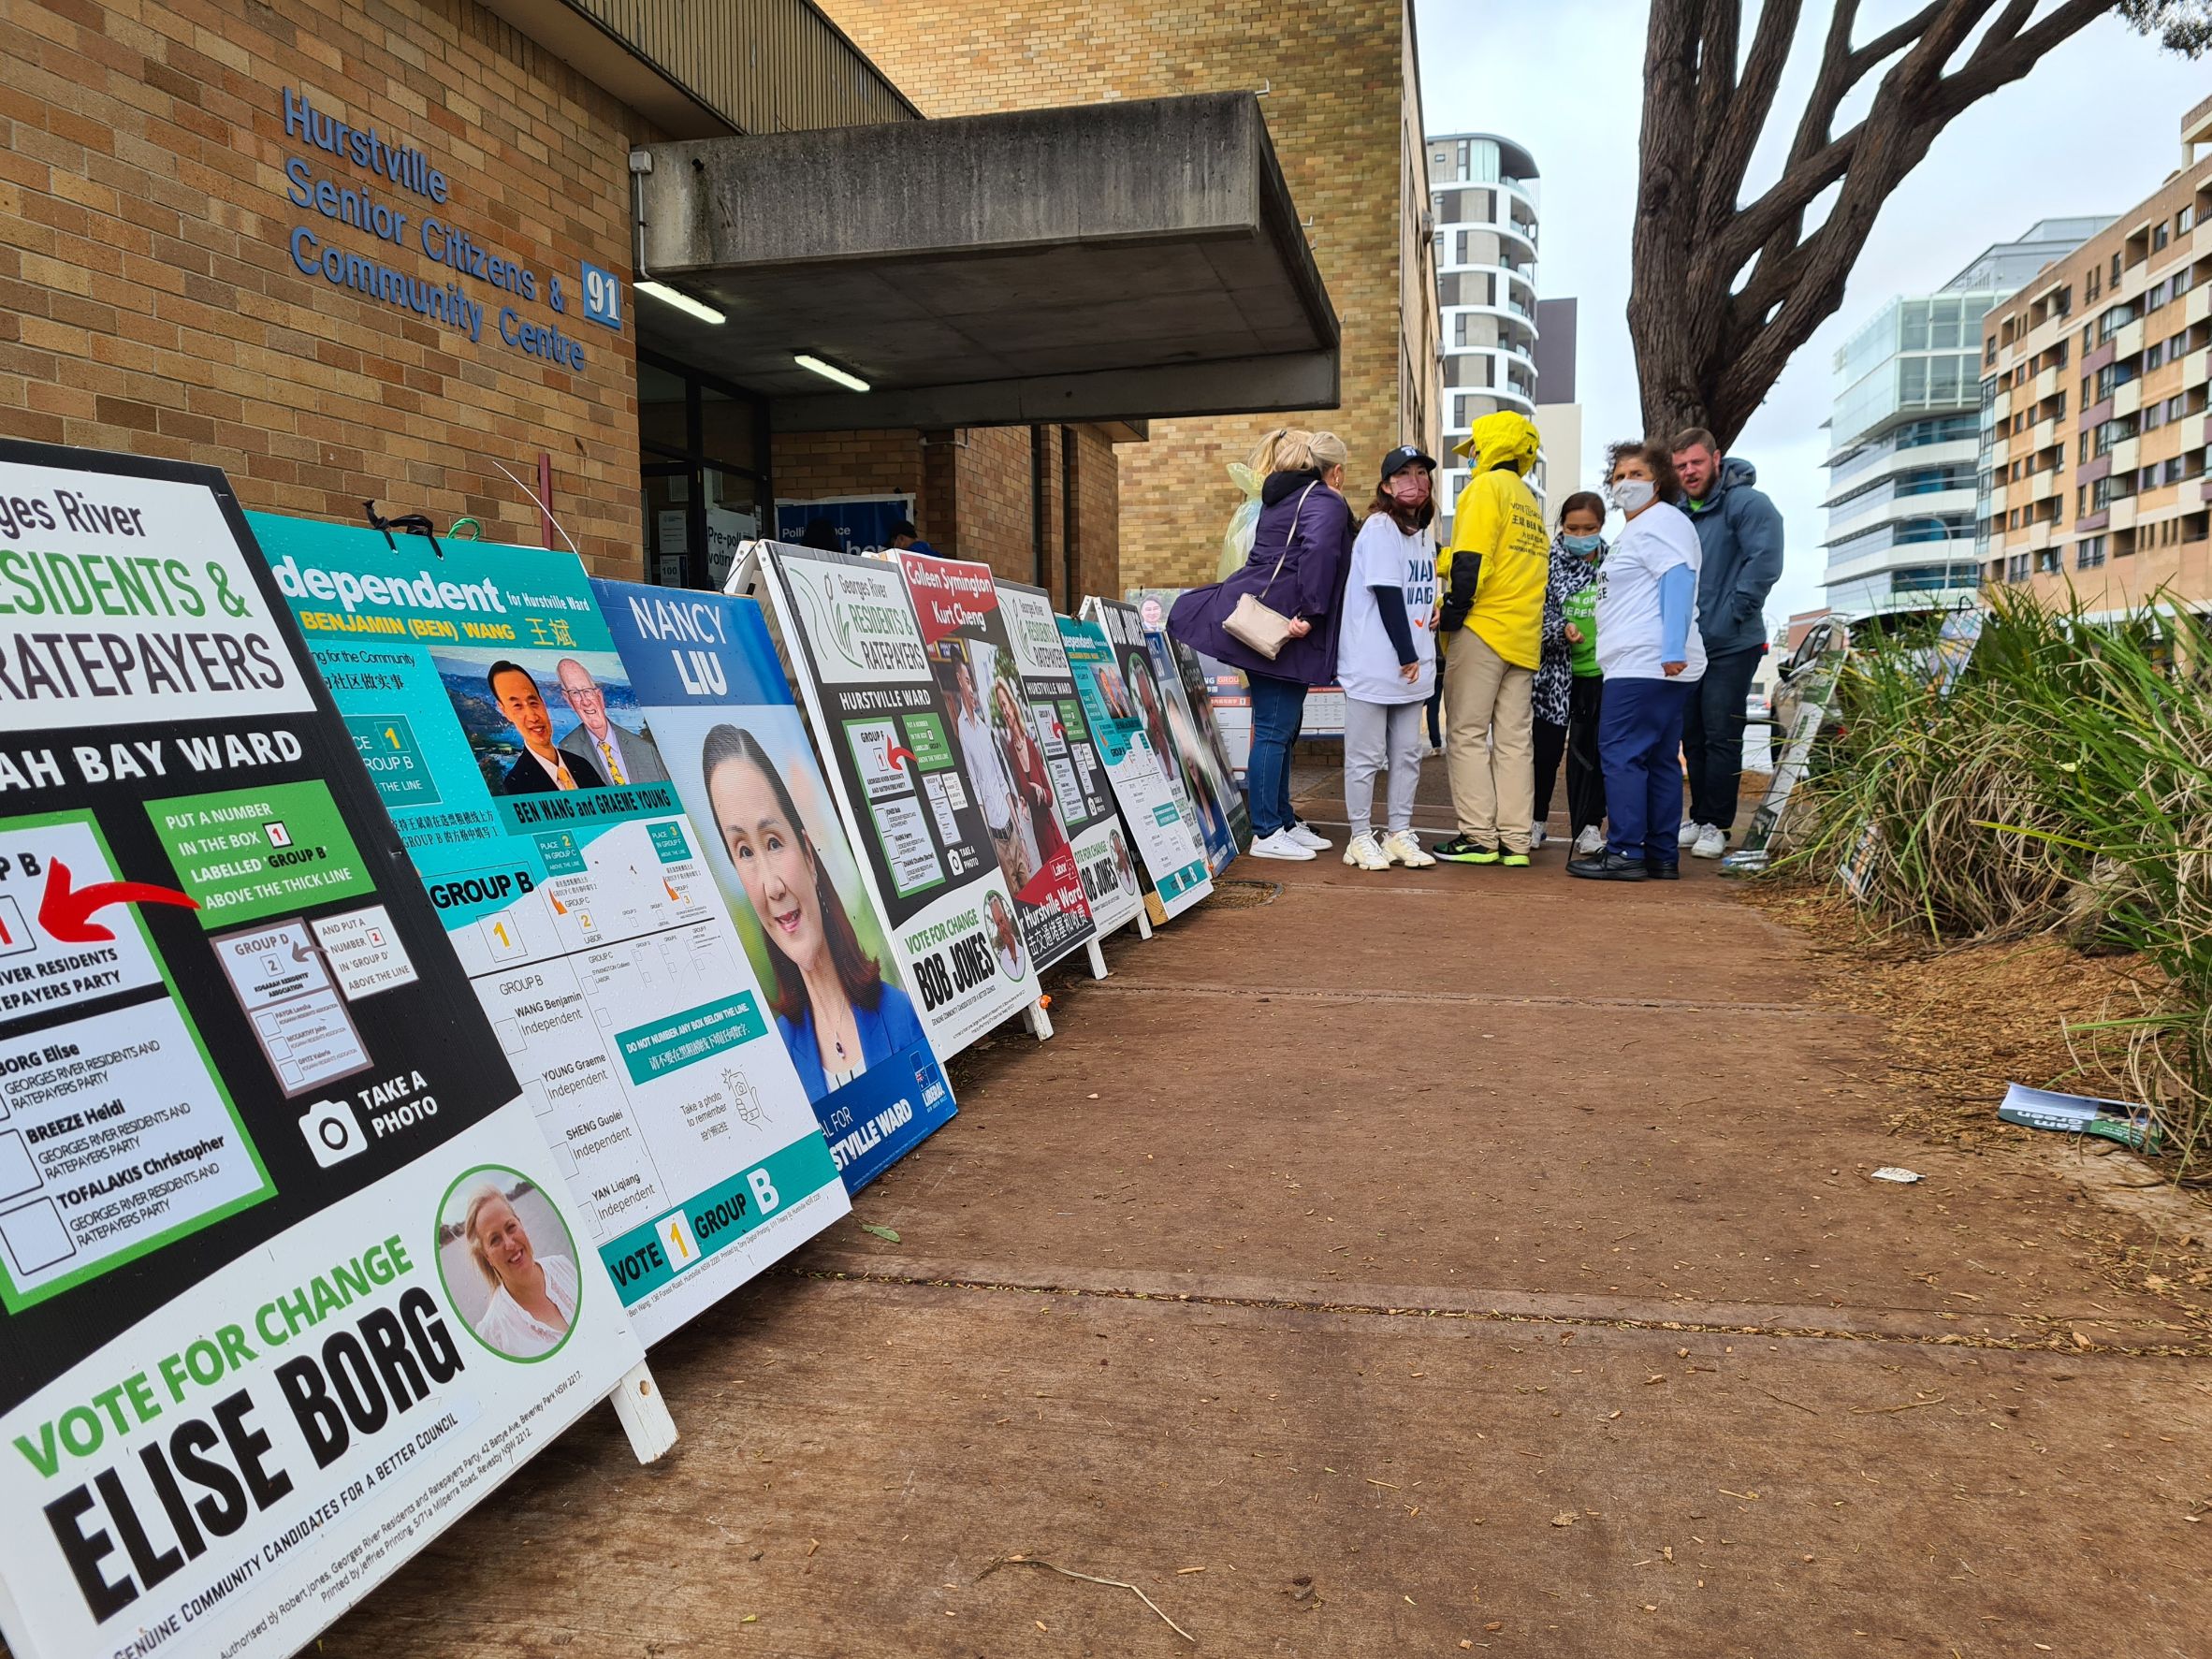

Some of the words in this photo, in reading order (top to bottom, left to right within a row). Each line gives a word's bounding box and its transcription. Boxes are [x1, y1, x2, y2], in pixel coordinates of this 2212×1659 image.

[283, 86, 448, 204] Hurstville
[285, 156, 407, 244] Senior
[421, 218, 536, 300] Citizens
[549, 276, 566, 313] &
[290, 226, 483, 342] Community
[499, 307, 585, 371] Centre
[588, 271, 619, 320] 91
[54, 489, 146, 536] River
[707, 526, 741, 546] Pre-poll
[782, 528, 806, 539] Polli
[271, 554, 506, 613] dependent
[506, 590, 521, 607] for
[521, 592, 566, 610] Hurstville
[567, 593, 590, 611] Ward
[662, 565, 677, 575] 100
[838, 574, 867, 601] Georges
[867, 577, 888, 599] River
[907, 561, 941, 586] Colleen
[941, 567, 993, 598] Symington
[206, 560, 254, 618] &
[299, 611, 406, 634] BENJAMIN
[409, 618, 458, 641] (BEN)
[463, 622, 516, 640] WANG
[524, 618, 576, 648] 王斌
[629, 597, 727, 644] NANCY
[848, 604, 905, 635] RESIDENTS
[903, 615, 914, 636] &
[932, 601, 953, 625] Kurt
[953, 608, 986, 631] Cheng
[327, 649, 339, 662] for
[342, 650, 359, 662] the
[359, 651, 415, 667] Community
[672, 649, 728, 695] LIU
[860, 640, 924, 670] RATEPAYERS
[839, 691, 901, 710] HURSTVILLE
[905, 689, 931, 706] WARD
[72, 741, 168, 783] BAY
[176, 730, 302, 772] WARD
[166, 813, 195, 829] PUT
[199, 812, 211, 824] A
[211, 803, 273, 822] NUMBER
[515, 801, 538, 823] BEN
[540, 797, 574, 822] WANG
[577, 797, 595, 815] and
[596, 793, 635, 815] GRAEME
[635, 788, 671, 809] YOUNG
[179, 842, 197, 856] IN
[197, 837, 228, 853] THE
[228, 831, 261, 847] BOX
[272, 828, 283, 841] 1
[960, 847, 971, 856] TAKE
[191, 859, 262, 883] LABELLED
[964, 858, 979, 870] PHOTO
[1053, 862, 1067, 876] Labor
[1093, 857, 1118, 897] JONES
[205, 889, 255, 910] ABOVE
[252, 881, 283, 899] THE
[280, 873, 323, 894] THICK
[323, 868, 353, 884] LINE
[429, 875, 511, 910] GROUP
[518, 870, 534, 895] B
[1023, 893, 1061, 929] Hurstville
[1057, 880, 1084, 908] Ward
[493, 921, 511, 948] 1
[905, 930, 932, 955] VOTE
[929, 922, 947, 945] FOR
[946, 909, 979, 937] CHANGE
[500, 977, 534, 996] GROUP
[534, 975, 543, 986] B
[912, 953, 953, 1011] BOB
[949, 932, 996, 994] JONES
[515, 1002, 544, 1018] WANG
[545, 992, 582, 1010] Benjamin
[521, 1008, 583, 1036] Independent
[626, 1042, 637, 1054] DO
[637, 1037, 651, 1048] NOT
[651, 1028, 678, 1044] NUMBER
[678, 1024, 691, 1035] ANY
[691, 1019, 704, 1030] BOX
[704, 1011, 724, 1026] BELOW
[724, 1008, 735, 1018] THE
[5, 1070, 57, 1095] GEORGES
[56, 1062, 85, 1078] RIVER
[85, 1046, 138, 1070] RESIDENTS
[138, 1041, 159, 1055] AND
[44, 1043, 80, 1063] Elise
[542, 1064, 575, 1083] YOUNG
[575, 1054, 605, 1070] Graeme
[10, 1080, 78, 1111] RATEPAYERS
[77, 1070, 109, 1091] PARTY
[358, 1077, 406, 1111] TAKE
[409, 1070, 428, 1089] A
[547, 1069, 608, 1099] Independent
[922, 1082, 945, 1107] LIBERAL
[371, 1097, 438, 1138] PHOTO
[680, 1102, 697, 1115] Take
[704, 1092, 722, 1106] photo
[687, 1117, 694, 1128] to
[694, 1103, 727, 1124] remember
[831, 1106, 853, 1131] FOR
[25, 1113, 84, 1143] BREEZE
[566, 1121, 597, 1141] SHENG
[597, 1109, 623, 1128] Guolei
[829, 1119, 880, 1171] STVILLE
[875, 1099, 912, 1138] WARD
[573, 1127, 632, 1159] Independent
[56, 1166, 142, 1209] TOFALAKIS
[142, 1136, 225, 1175] Christopher
[591, 1187, 614, 1201] YAN
[611, 1173, 641, 1191] Liqiang
[598, 1184, 655, 1220] Independent
[611, 1242, 662, 1287] VOTE
[670, 1222, 688, 1259] 1
[694, 1193, 746, 1239] GROUP
[747, 1168, 779, 1215] B
[13, 1370, 162, 1479] VOTE
[157, 1322, 259, 1404] FOR
[254, 1233, 415, 1347] CHANGE
[42, 1388, 294, 1625] ELISE
[273, 1287, 466, 1470] BORG
[181, 1554, 261, 1623] COMMUNITY
[264, 1499, 340, 1563] CANDIDATES
[340, 1481, 365, 1507] FOR
[367, 1474, 376, 1490] A
[376, 1442, 416, 1480] BETTER
[415, 1412, 458, 1449] COUNCIL
